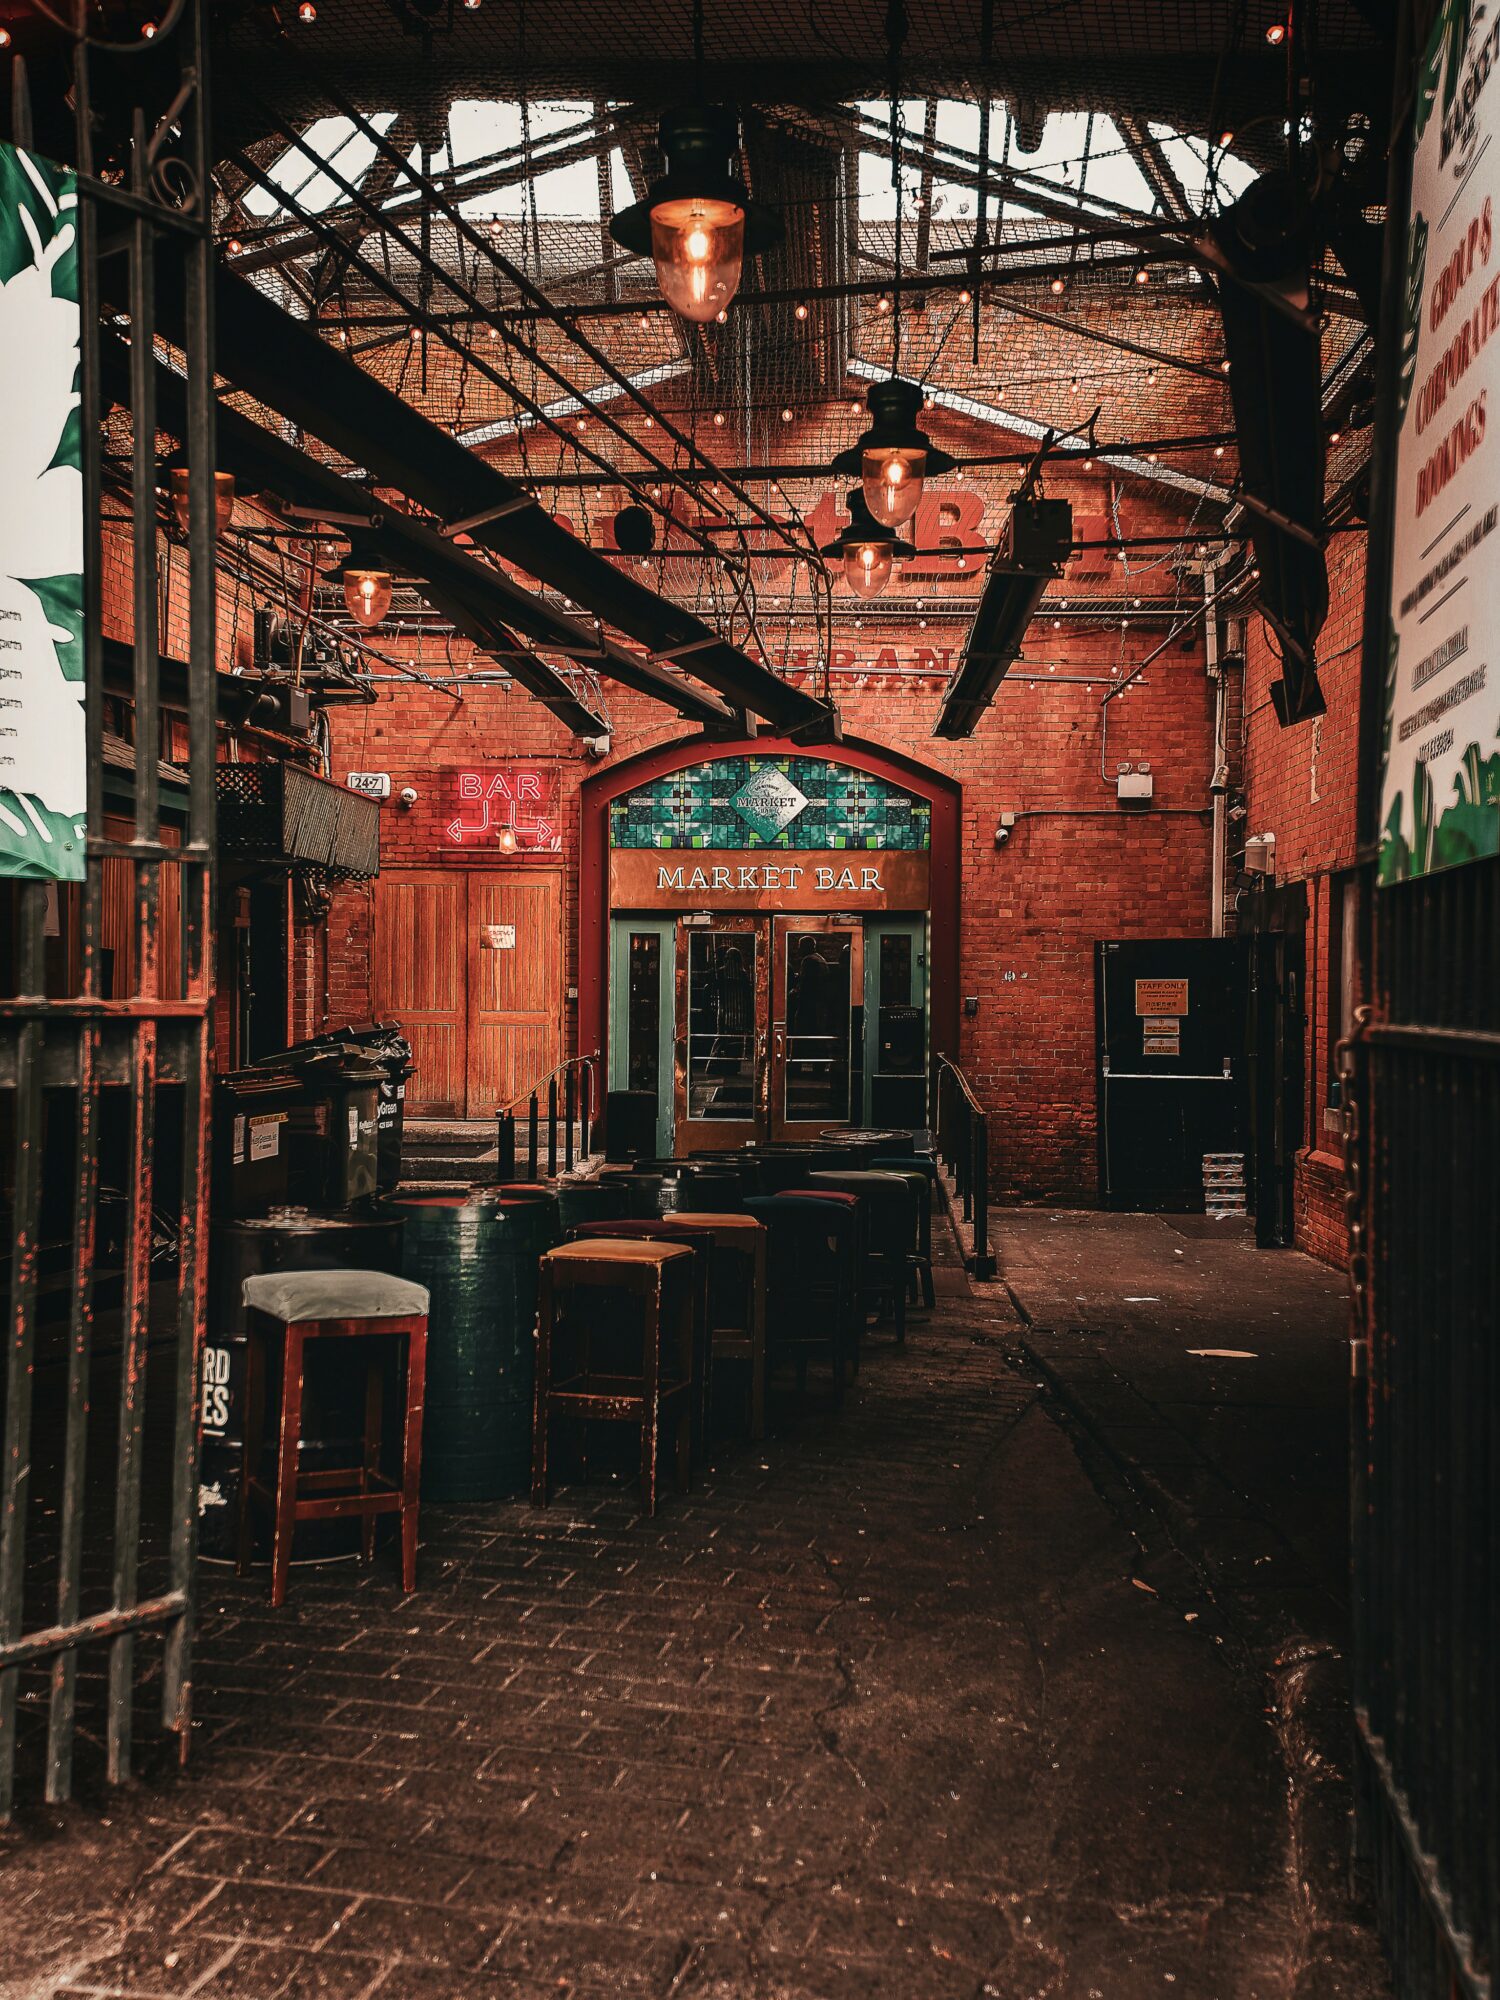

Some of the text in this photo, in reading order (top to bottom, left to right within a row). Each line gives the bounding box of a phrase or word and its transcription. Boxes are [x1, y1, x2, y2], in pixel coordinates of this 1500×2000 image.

[460, 773, 541, 800] BAR
[737, 797, 796, 807] MARKET
[655, 866, 885, 891] MARKET BAR
